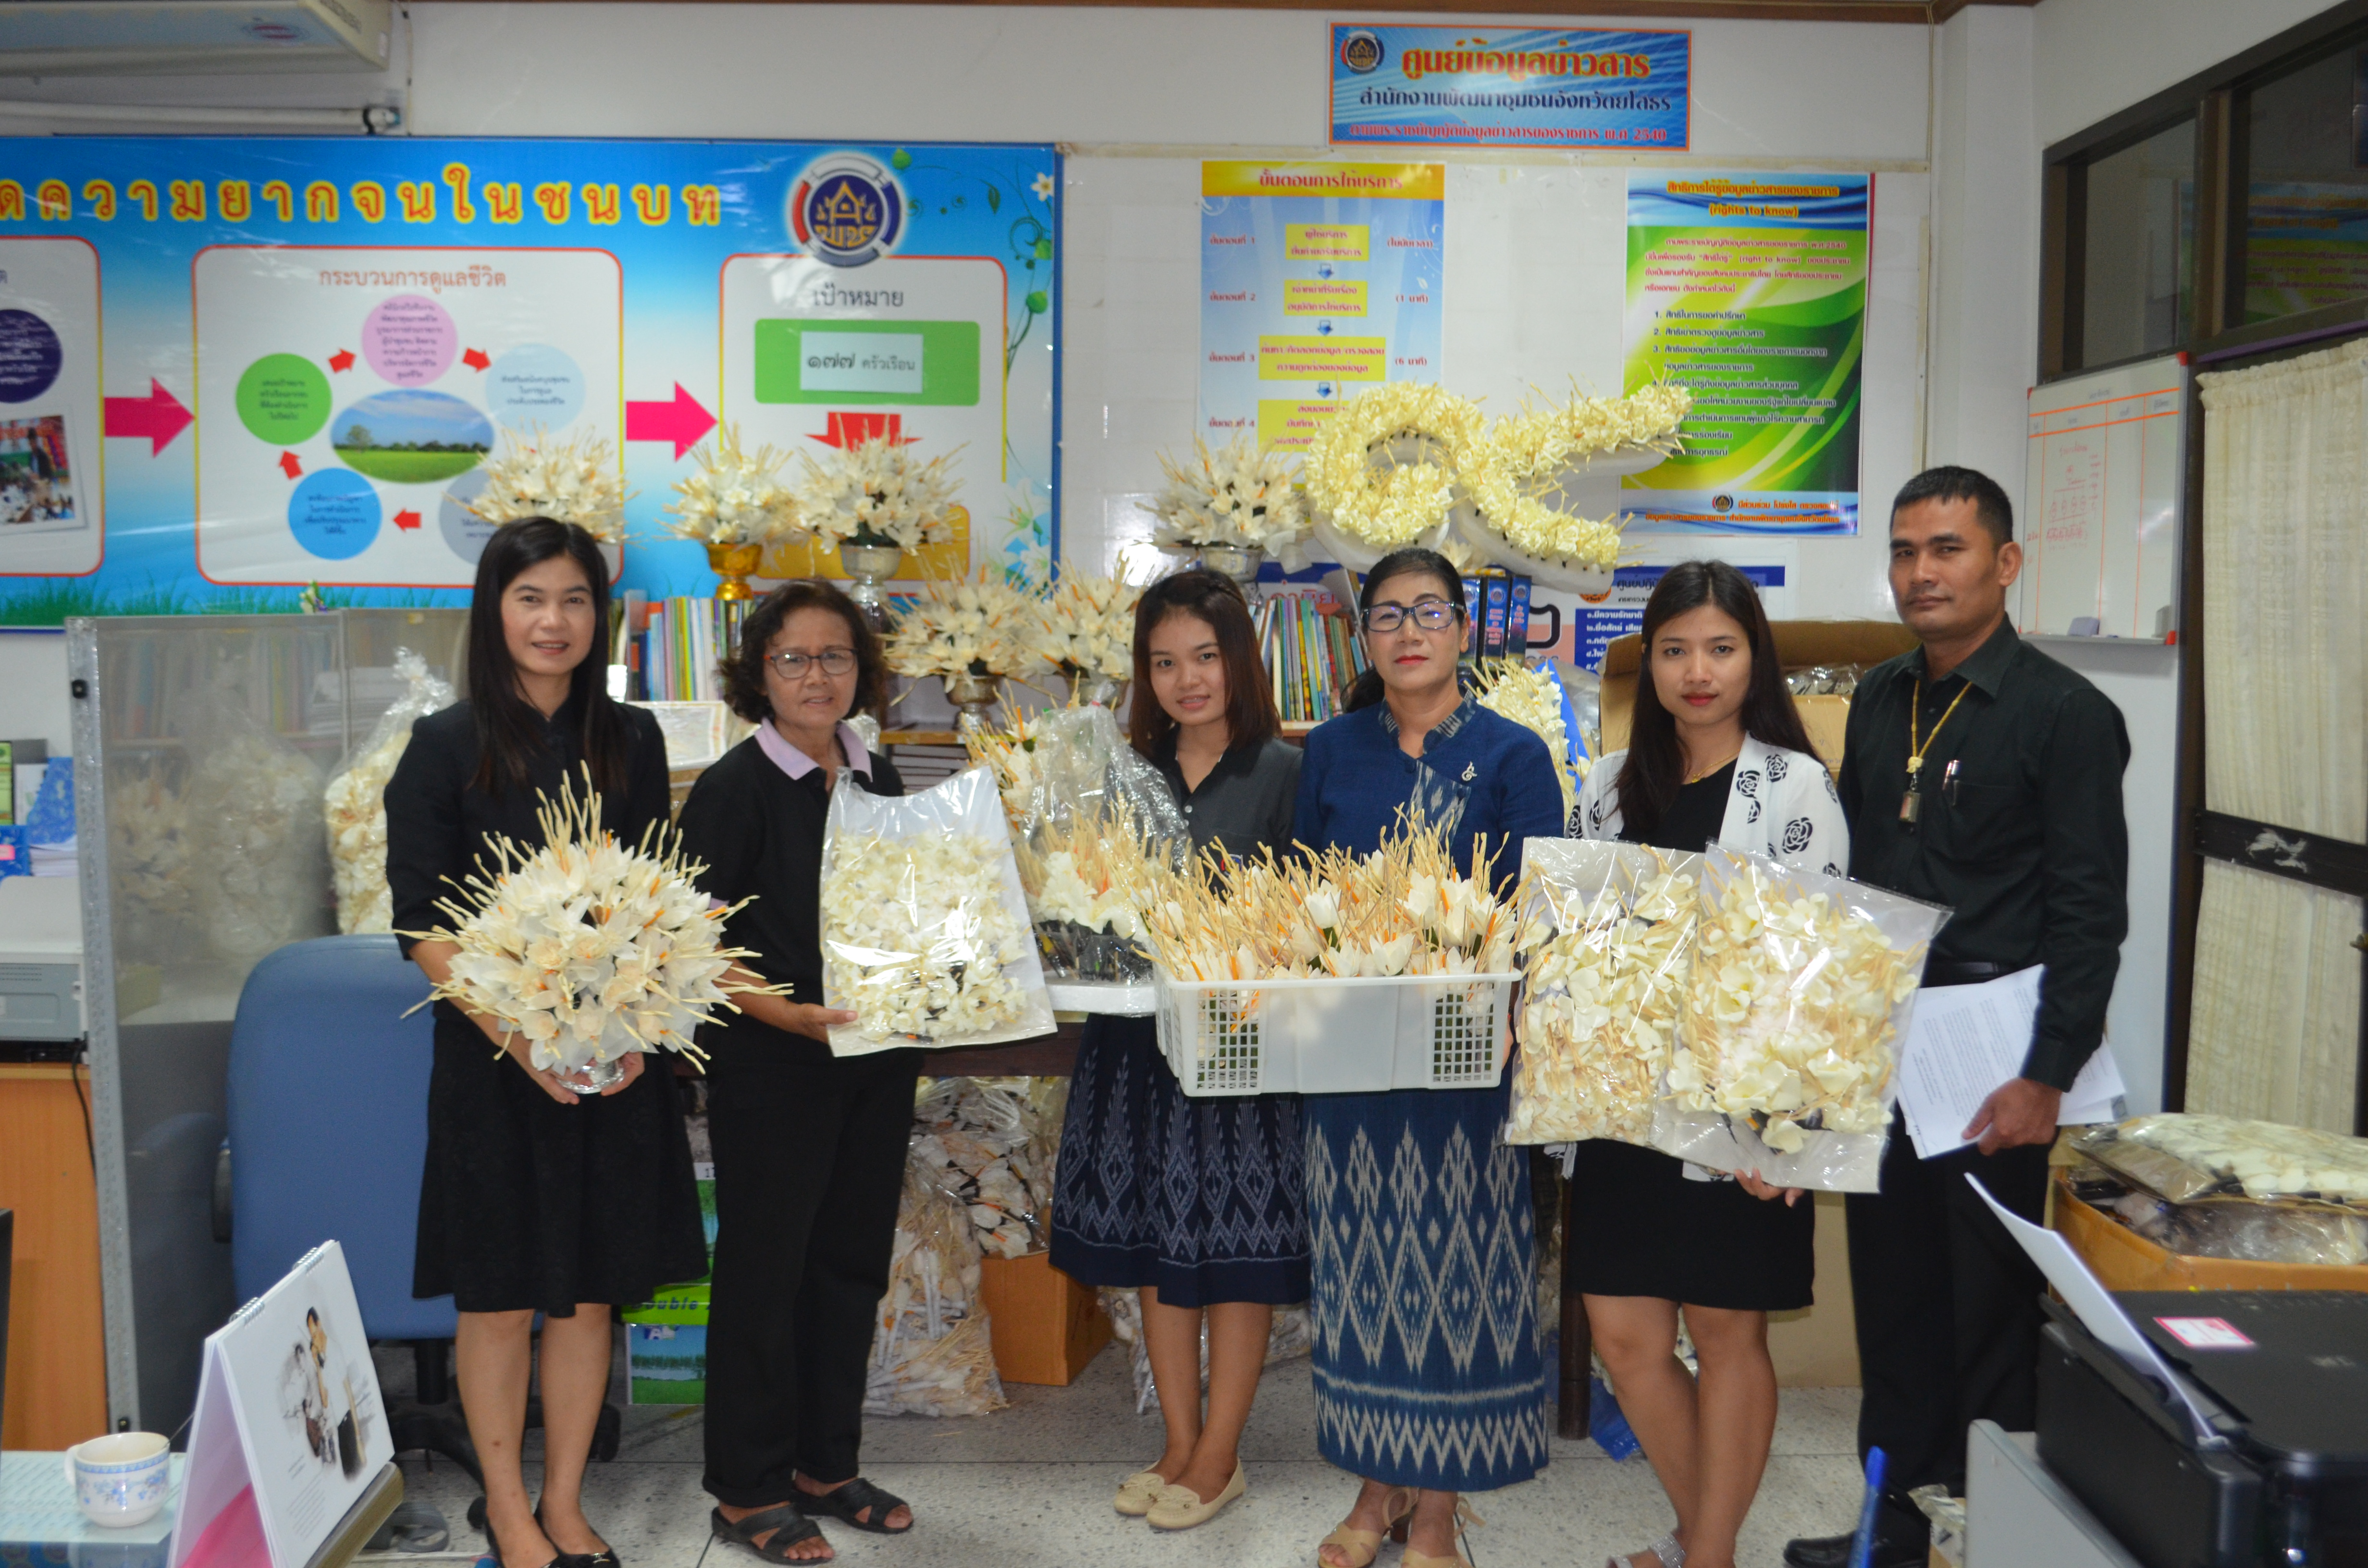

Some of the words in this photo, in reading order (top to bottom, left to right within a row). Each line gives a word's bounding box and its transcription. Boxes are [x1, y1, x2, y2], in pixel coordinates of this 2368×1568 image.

[1402, 38, 1650, 80] ศูนย์ข้อมูลข่าวสาร
[1360, 87, 1671, 112] สำนักงานพัฒนาชุมชนจังหวัดยโสธร
[1633, 129, 1666, 141] 2540
[1259, 167, 1403, 189] ขั้นตอนการให้บริการ
[1709, 203, 1746, 217] (rights
[1749, 205, 1762, 216] to
[1764, 205, 1799, 218] know)
[1251, 236, 1255, 244] 1
[1776, 256, 1801, 266] know)
[319, 264, 506, 293] กระบวนการดูแลชีวิต
[813, 282, 904, 307] เป้าหมาย
[1654, 311, 1662, 319] 1.
[1653, 345, 1660, 353] 3.
[808, 353, 856, 371] ๑๗๗
[862, 354, 915, 371] ครัวเรือน
[1249, 354, 1255, 362] 3
